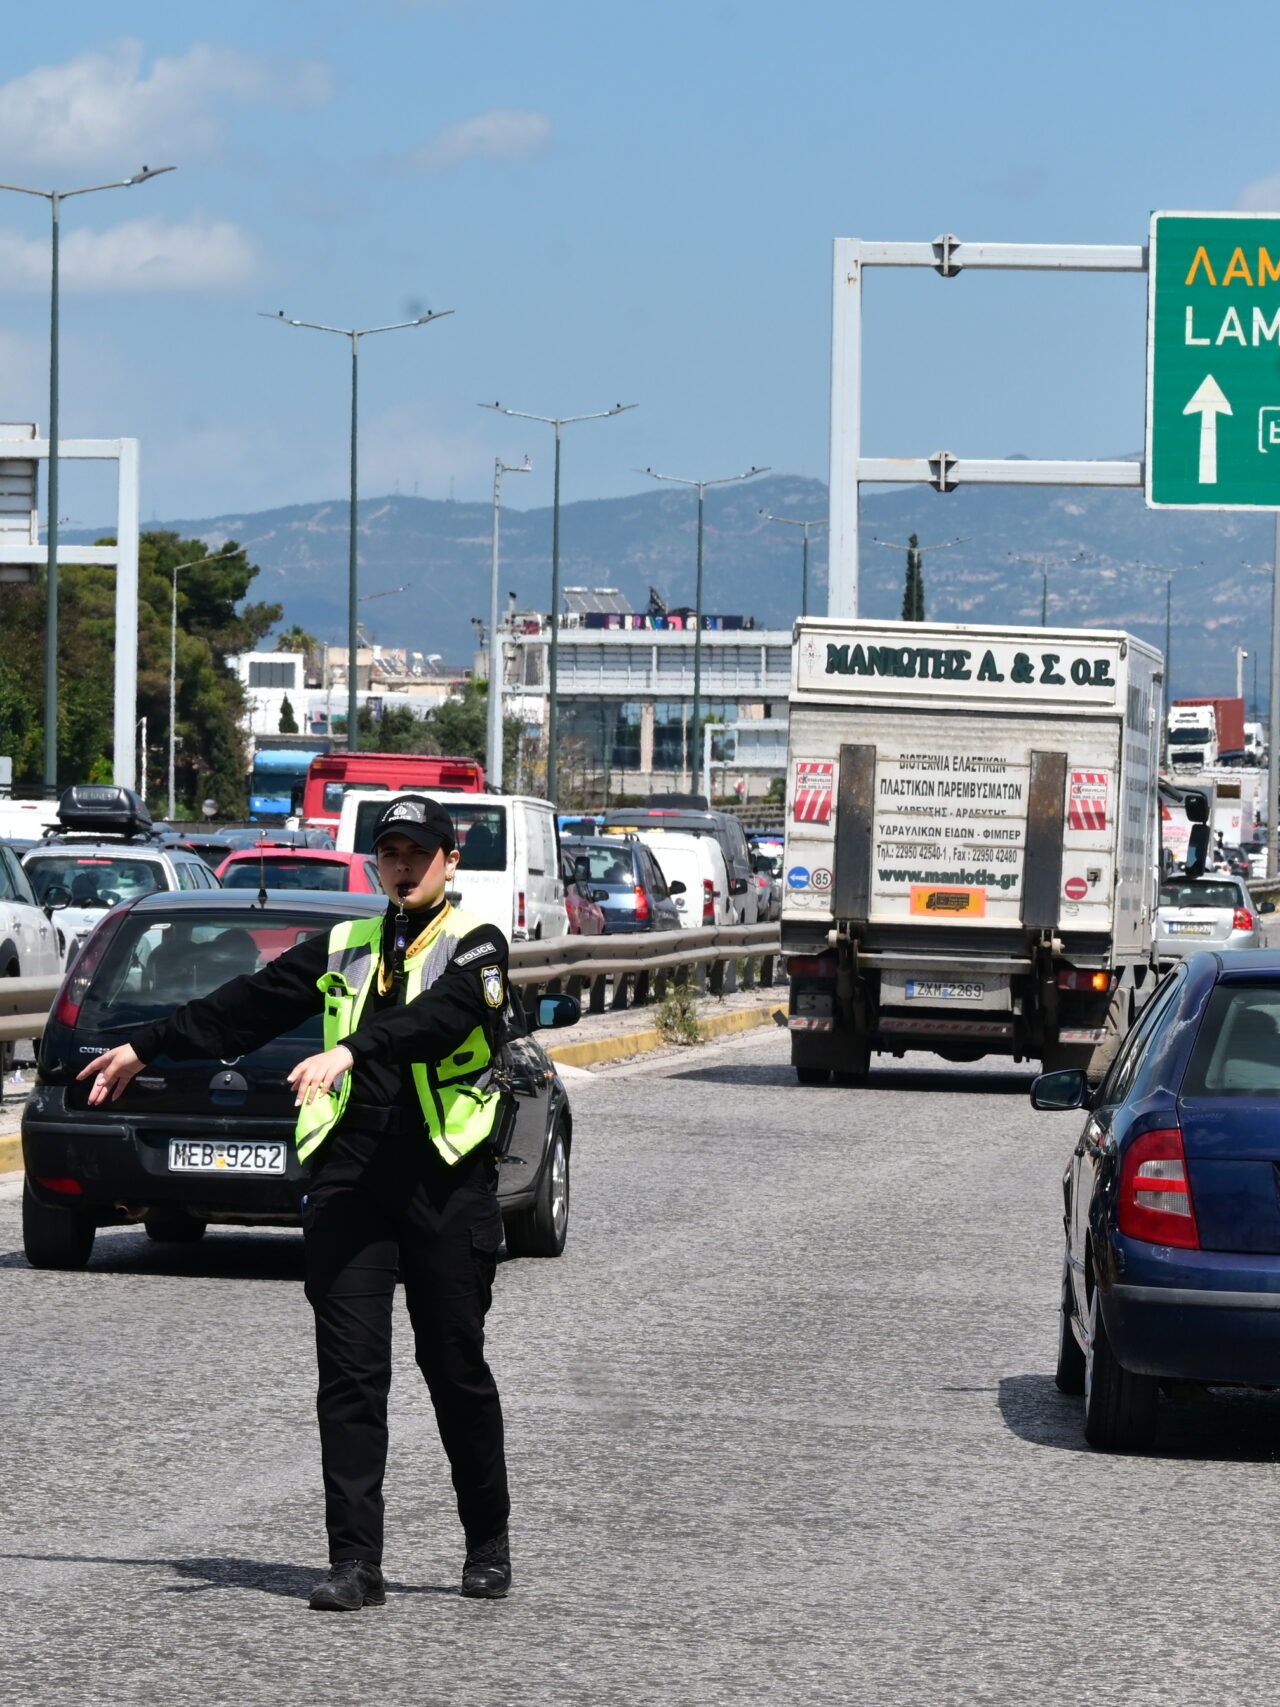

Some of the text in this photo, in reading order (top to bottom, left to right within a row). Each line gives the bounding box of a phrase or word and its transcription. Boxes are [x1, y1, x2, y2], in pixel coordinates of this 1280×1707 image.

[825, 643, 971, 680] ΜΑΝΙΩΤΗΣ
[1010, 652, 1034, 683] &
[880, 779, 1022, 800] ΠΛΑΣΤΙΚΩΝ ΠΑΡΕΜΒΥΣΜΑΤΩΝ
[879, 825, 942, 837] ΥΔΡΑΥΛΙΚΩΝ
[944, 827, 974, 838] ΕΙΔΩΝ
[983, 829, 1021, 840] ΦΙΜΠΕΡ
[896, 845, 917, 859] 22950
[972, 848, 994, 862] 22950
[815, 873, 828, 886] 85
[878, 868, 1019, 890] www.maniotis.gr
[457, 944, 494, 964] POLICE
